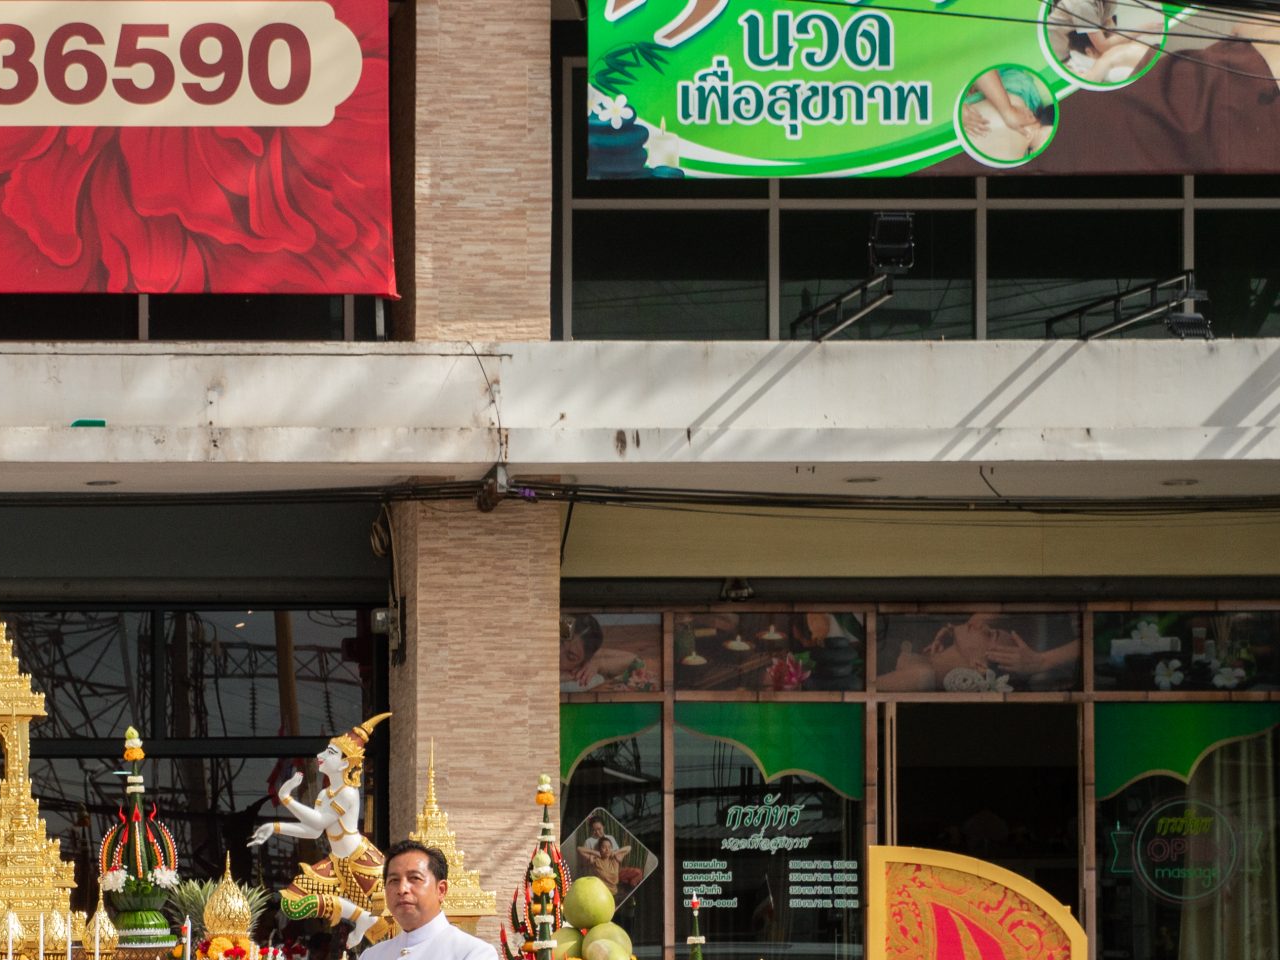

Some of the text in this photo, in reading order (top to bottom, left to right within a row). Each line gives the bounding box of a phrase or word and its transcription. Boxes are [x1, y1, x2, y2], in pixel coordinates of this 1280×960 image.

[740, 12, 893, 69] นวด
[678, 58, 930, 138] เพื่อสุขภาพ
